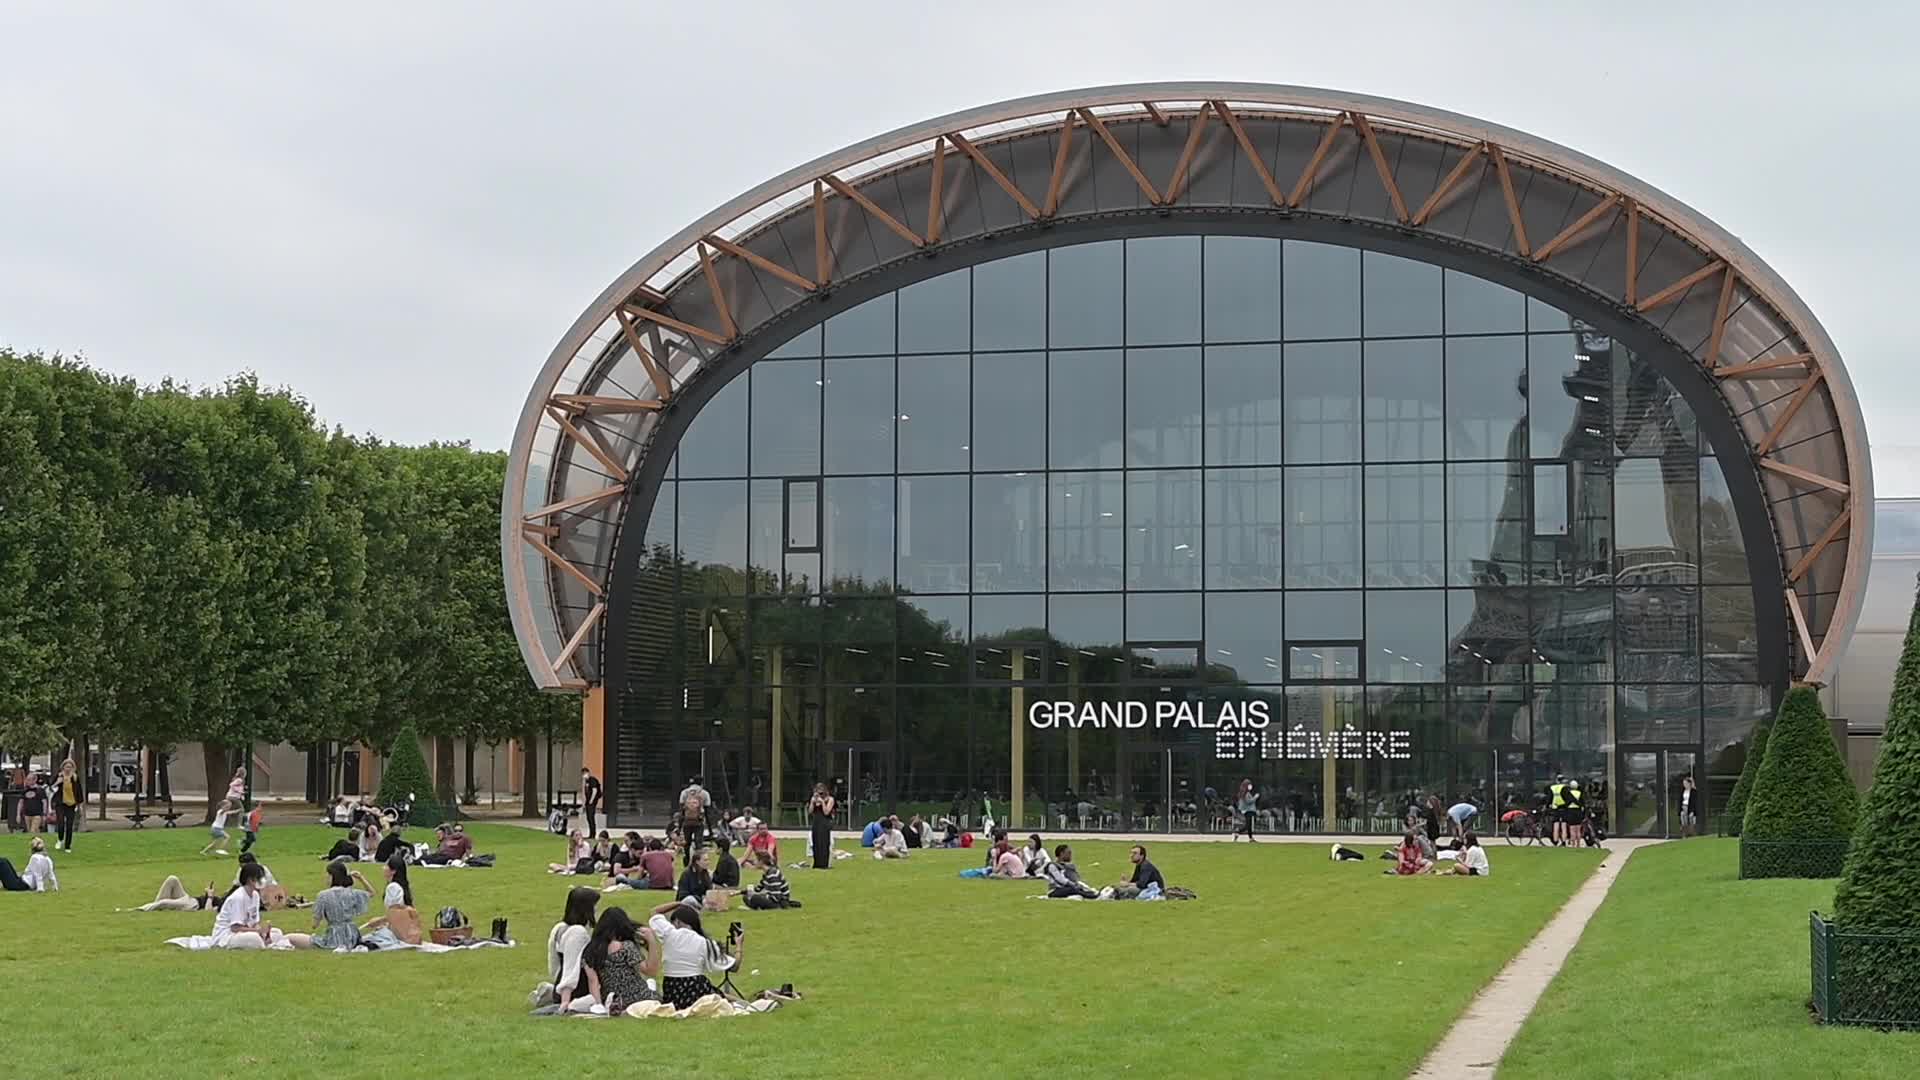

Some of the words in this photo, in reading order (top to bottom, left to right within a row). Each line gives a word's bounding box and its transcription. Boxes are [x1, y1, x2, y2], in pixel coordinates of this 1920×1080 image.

[1029, 701, 1148, 729] GRAND
[1156, 701, 1270, 729] PALAIS
[1215, 724, 1411, 759] ÉPHÉMÈRE
